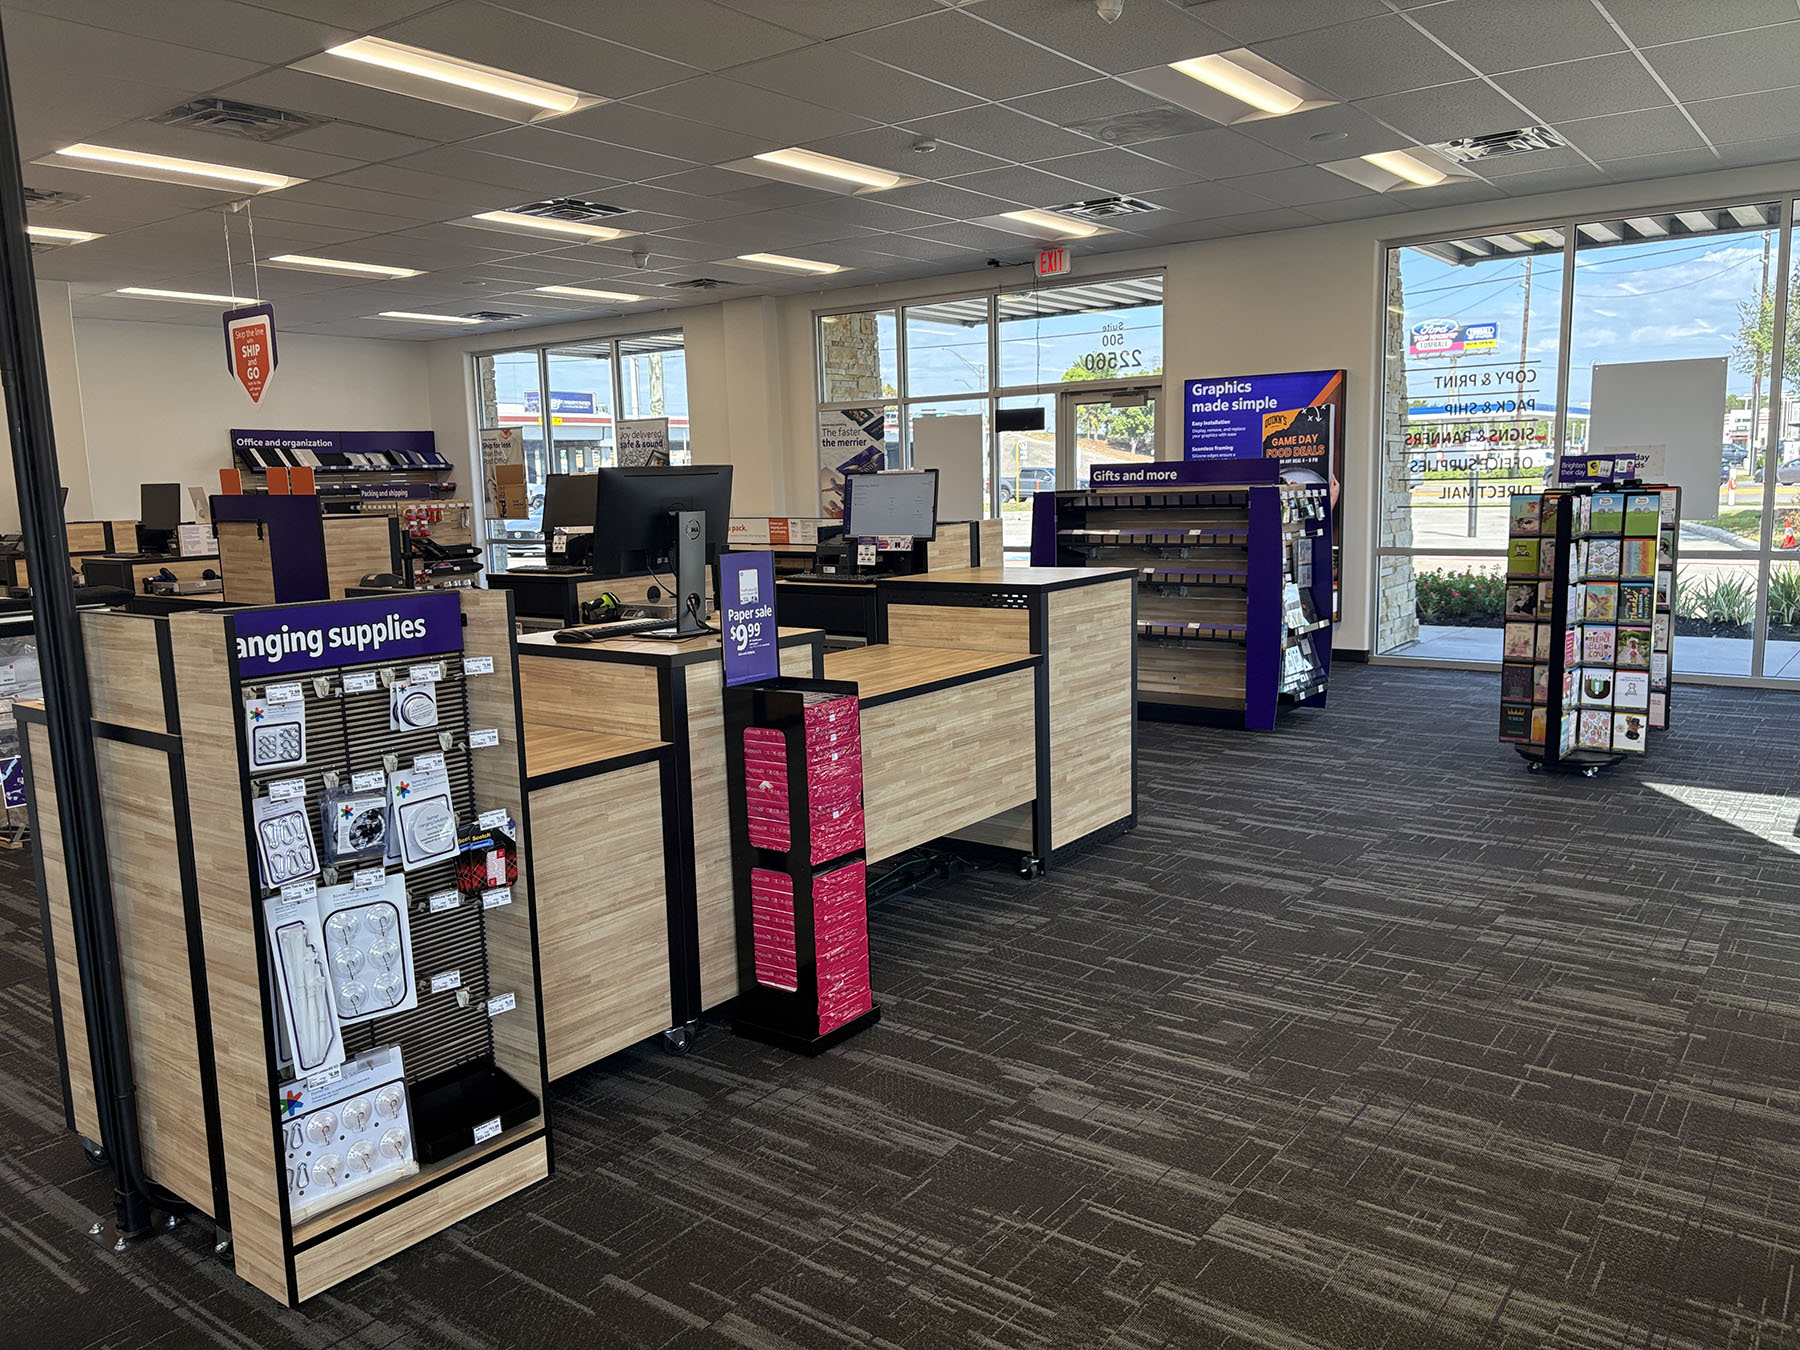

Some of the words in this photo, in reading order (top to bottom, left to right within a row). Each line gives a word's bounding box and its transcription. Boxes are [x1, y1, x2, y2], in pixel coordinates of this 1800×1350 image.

[1040, 249, 1064, 274] EXIT
[246, 328, 254, 337] the
[1420, 322, 1448, 334] Ford
[241, 344, 260, 358] SHIP
[248, 358, 257, 366] and
[246, 366, 260, 380] GO
[1192, 380, 1252, 398] Graphics
[1192, 399, 1229, 413] made
[1231, 396, 1278, 413] simple
[620, 432, 630, 440] Joy
[822, 428, 838, 437] The
[839, 428, 861, 437] faster
[236, 438, 263, 446] Office
[264, 438, 280, 446] and
[282, 438, 333, 448] organization
[620, 440, 634, 448] safe
[635, 440, 640, 448] &
[642, 439, 664, 448] sound
[837, 438, 867, 447] merrier
[1272, 436, 1297, 446] GAME
[1298, 434, 1319, 444] DAY
[1266, 447, 1292, 458] FOOD
[1293, 444, 1325, 457] DEALS
[1562, 462, 1586, 470] Brighten
[1093, 470, 1120, 482] Gifts
[1122, 469, 1144, 480] and
[1146, 471, 1178, 480] more
[1574, 470, 1586, 478] day
[728, 608, 754, 624] Paper
[754, 604, 772, 618] sale
[328, 614, 426, 652] supplies
[472, 832, 492, 842] Scotch
